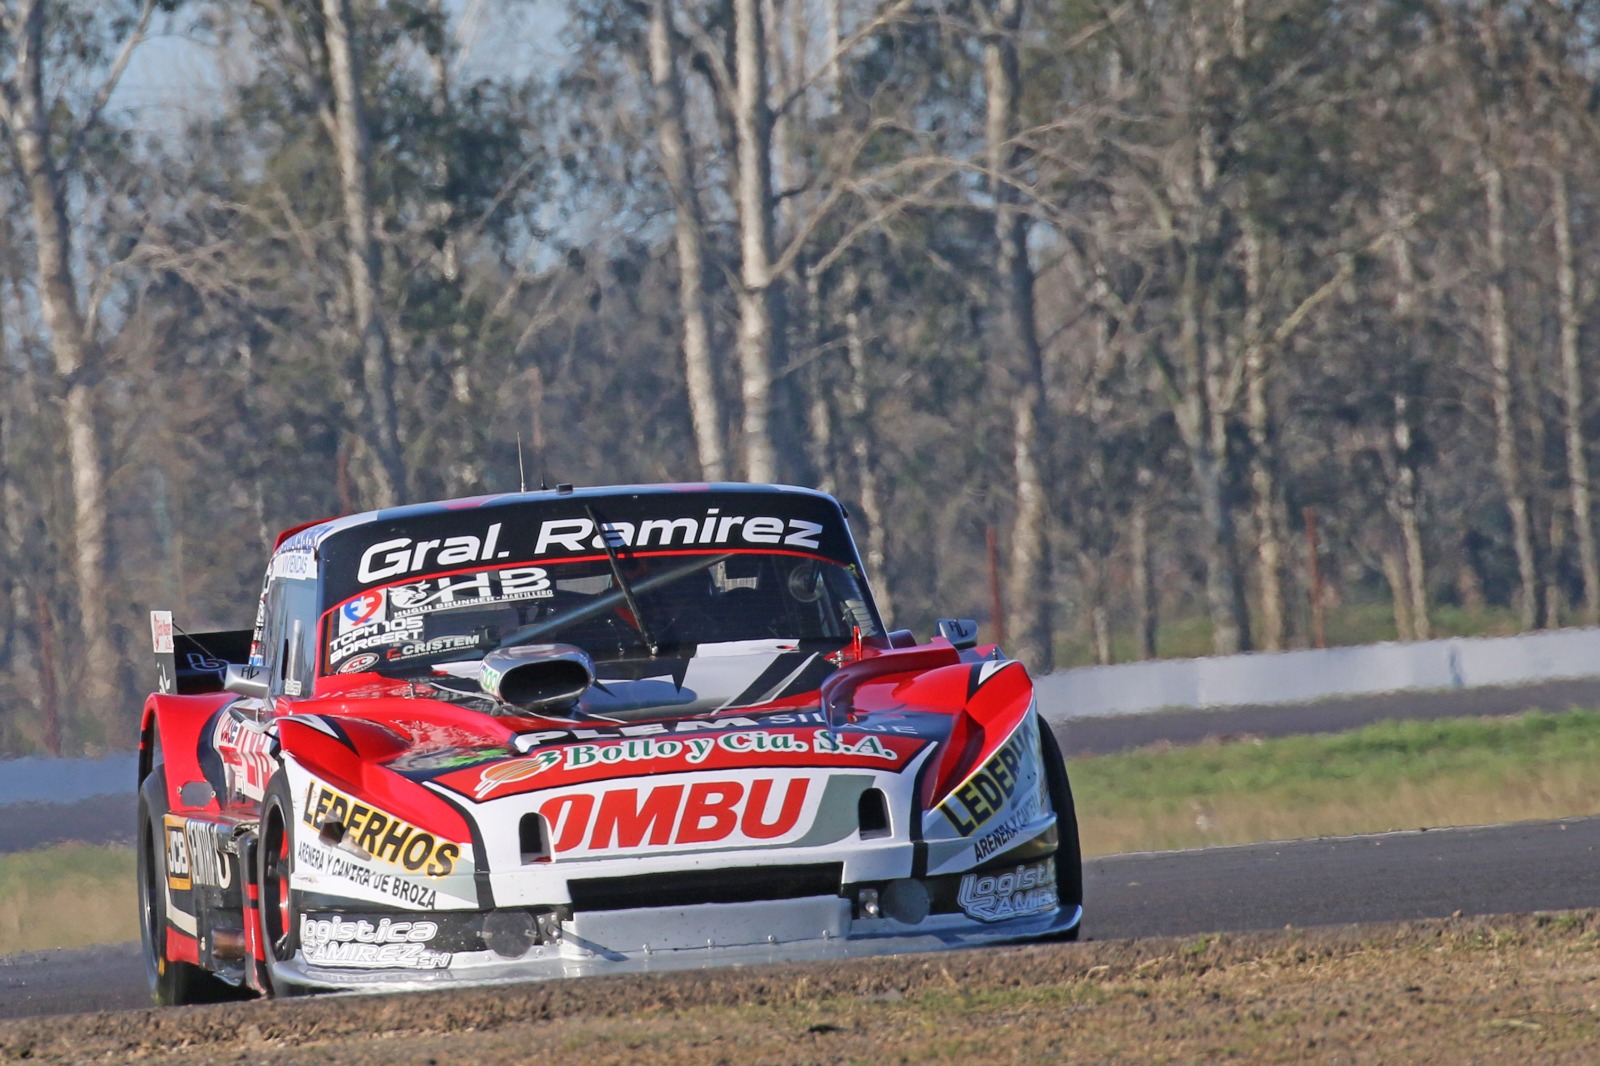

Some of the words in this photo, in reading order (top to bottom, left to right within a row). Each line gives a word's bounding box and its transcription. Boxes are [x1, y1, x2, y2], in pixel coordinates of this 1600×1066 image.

[357, 521, 509, 584] Gral.
[533, 507, 824, 556] Ramirez
[501, 588, 553, 600] MARTILLERO
[329, 623, 378, 652] TCPM
[382, 616, 423, 633] 105
[329, 628, 423, 665] BORGERT
[402, 634, 480, 655] CRISTEM
[563, 737, 682, 768] Bollo
[688, 739, 712, 763] y
[718, 732, 808, 752] Cia.
[816, 730, 896, 758] S.A.
[303, 780, 461, 878] LEDERHOS
[538, 777, 811, 853] OMBU
[168, 830, 189, 874] JCB
[297, 840, 325, 872] ARENERA
[326, 855, 334, 871] Y
[373, 873, 391, 893] DE
[392, 877, 437, 910] BROZA
